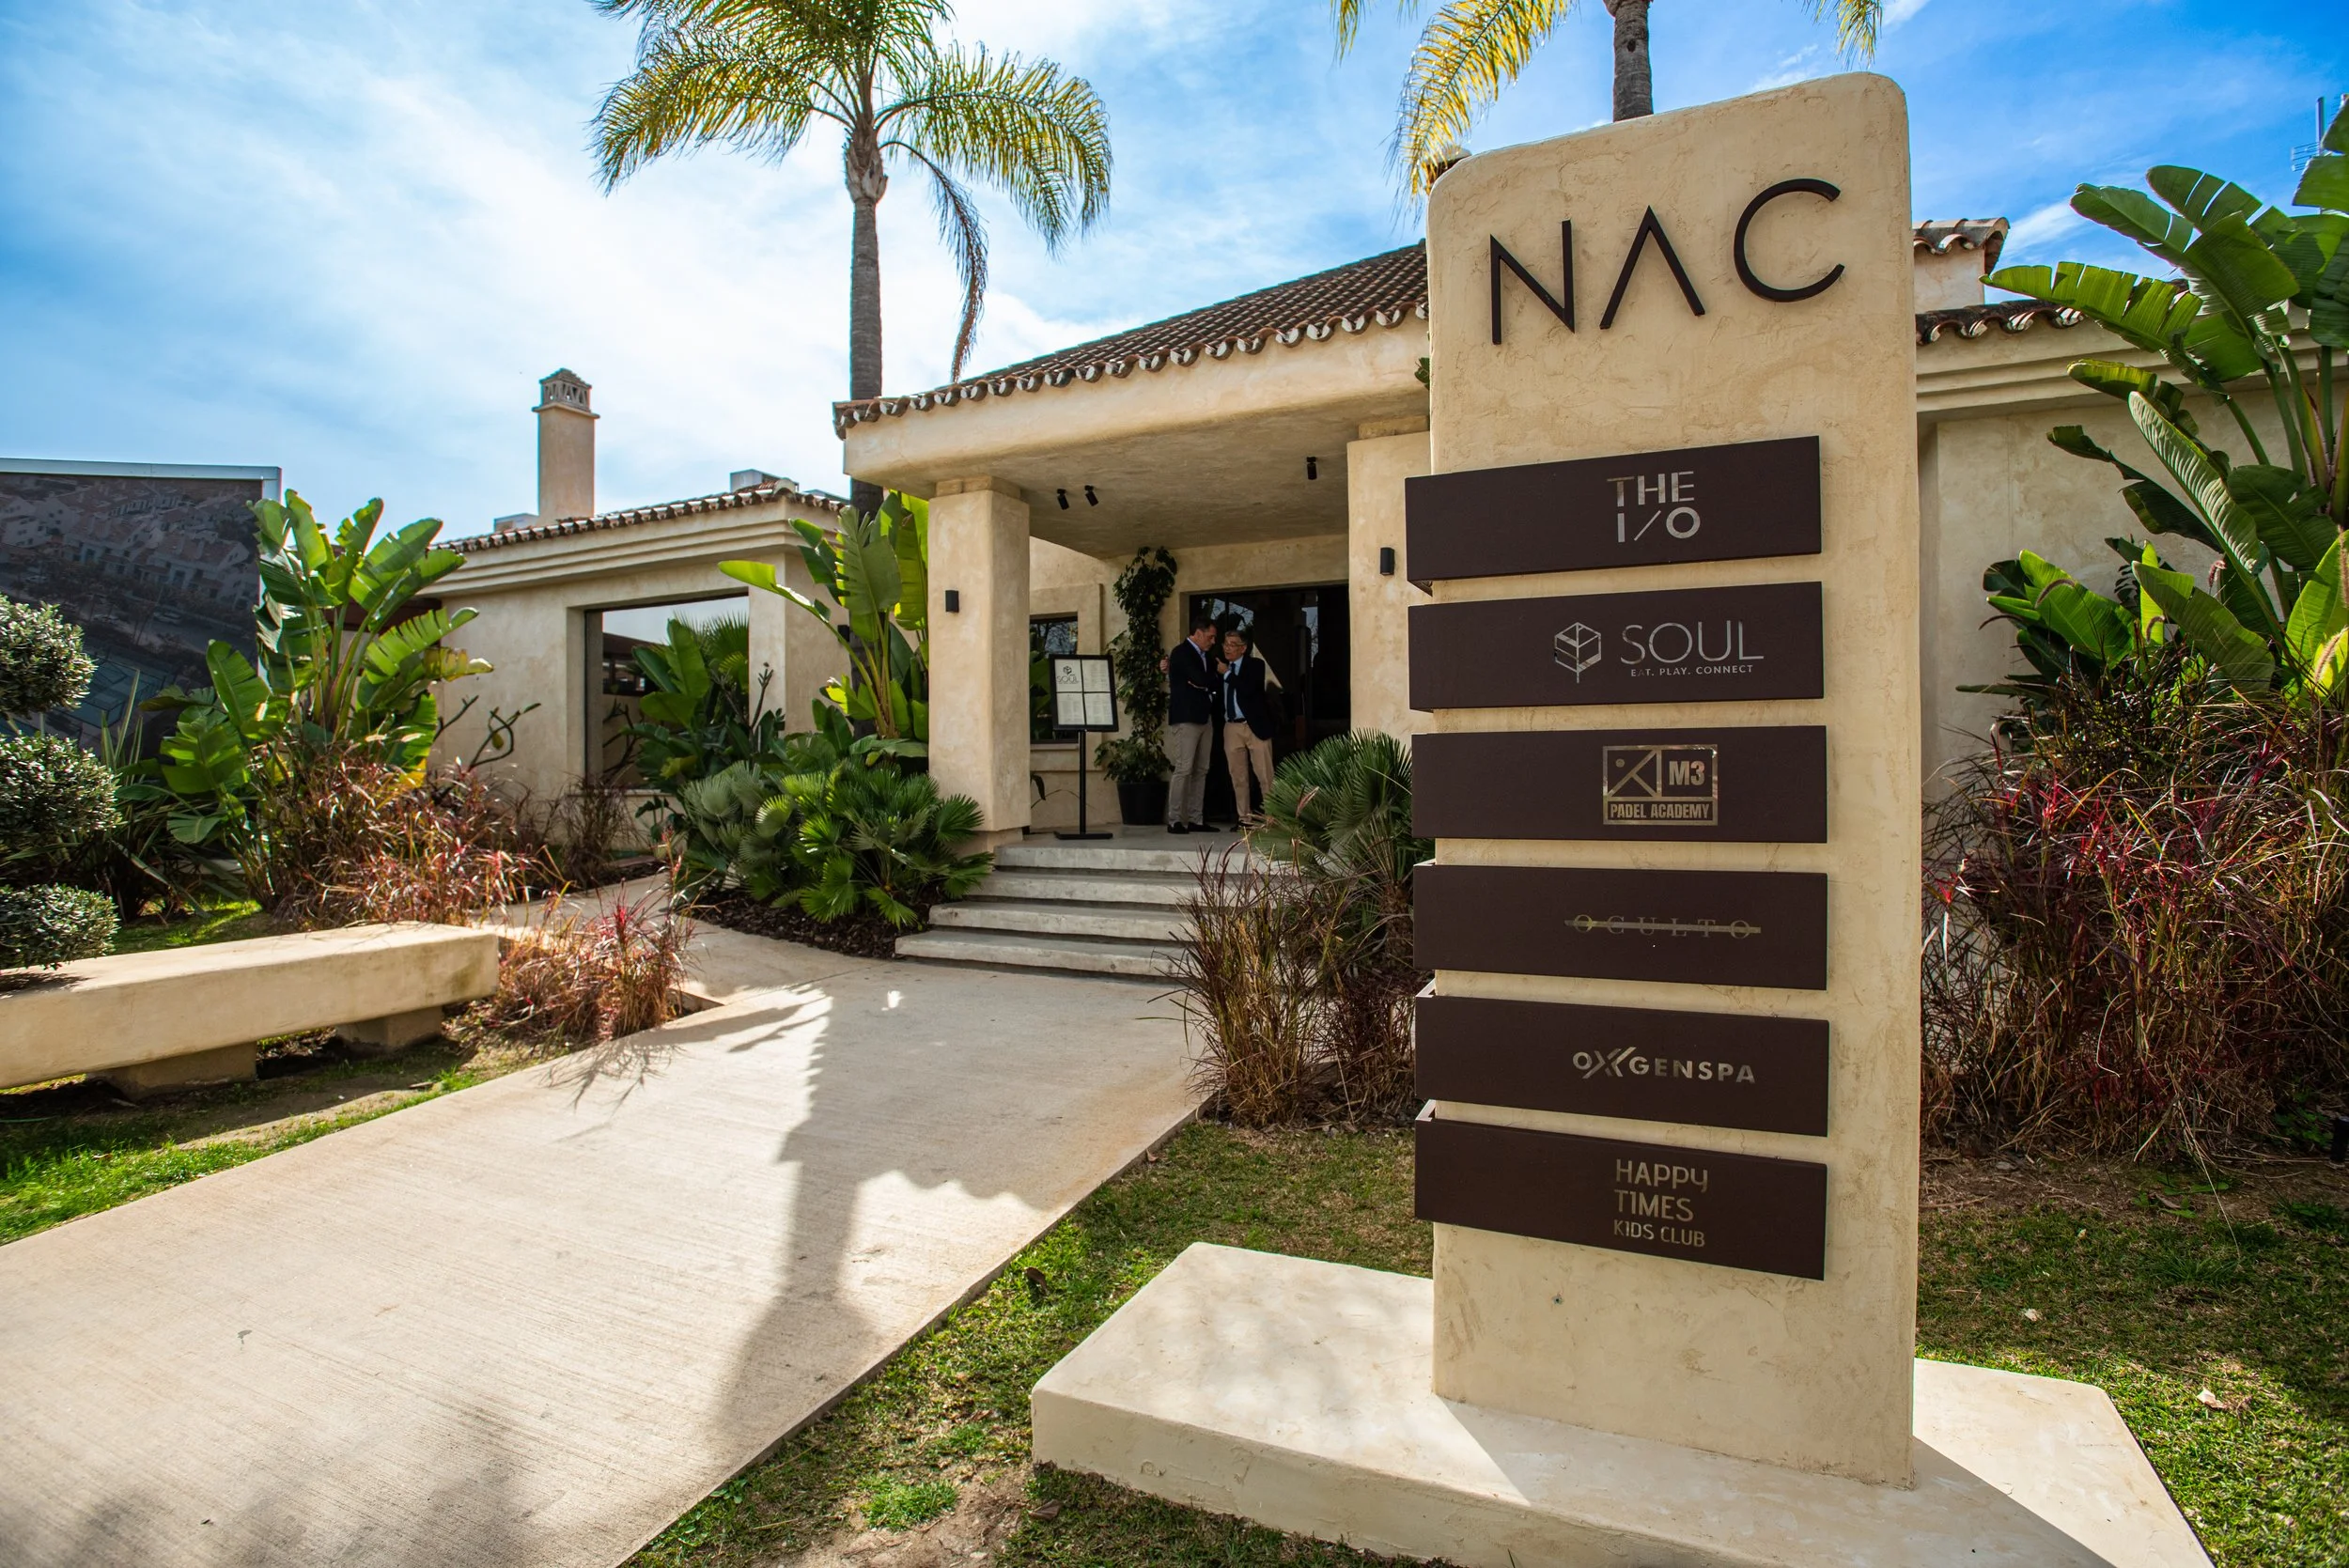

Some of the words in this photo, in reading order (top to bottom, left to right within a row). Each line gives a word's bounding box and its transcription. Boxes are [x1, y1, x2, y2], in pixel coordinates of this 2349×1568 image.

[1489, 178, 1845, 345] NAC
[1607, 471, 1694, 507] THE
[1616, 506, 1701, 543] I/O
[1620, 620, 1765, 665] SOUL
[1695, 664, 1753, 675] CONNECT
[1668, 760, 1705, 786] M3
[1610, 803, 1646, 819] PADEL
[1650, 803, 1710, 819] ACADEMY
[1614, 1188, 1694, 1222] TIMES
[1613, 1219, 1655, 1240] KIDS
[1660, 1226, 1705, 1248] CLUB
